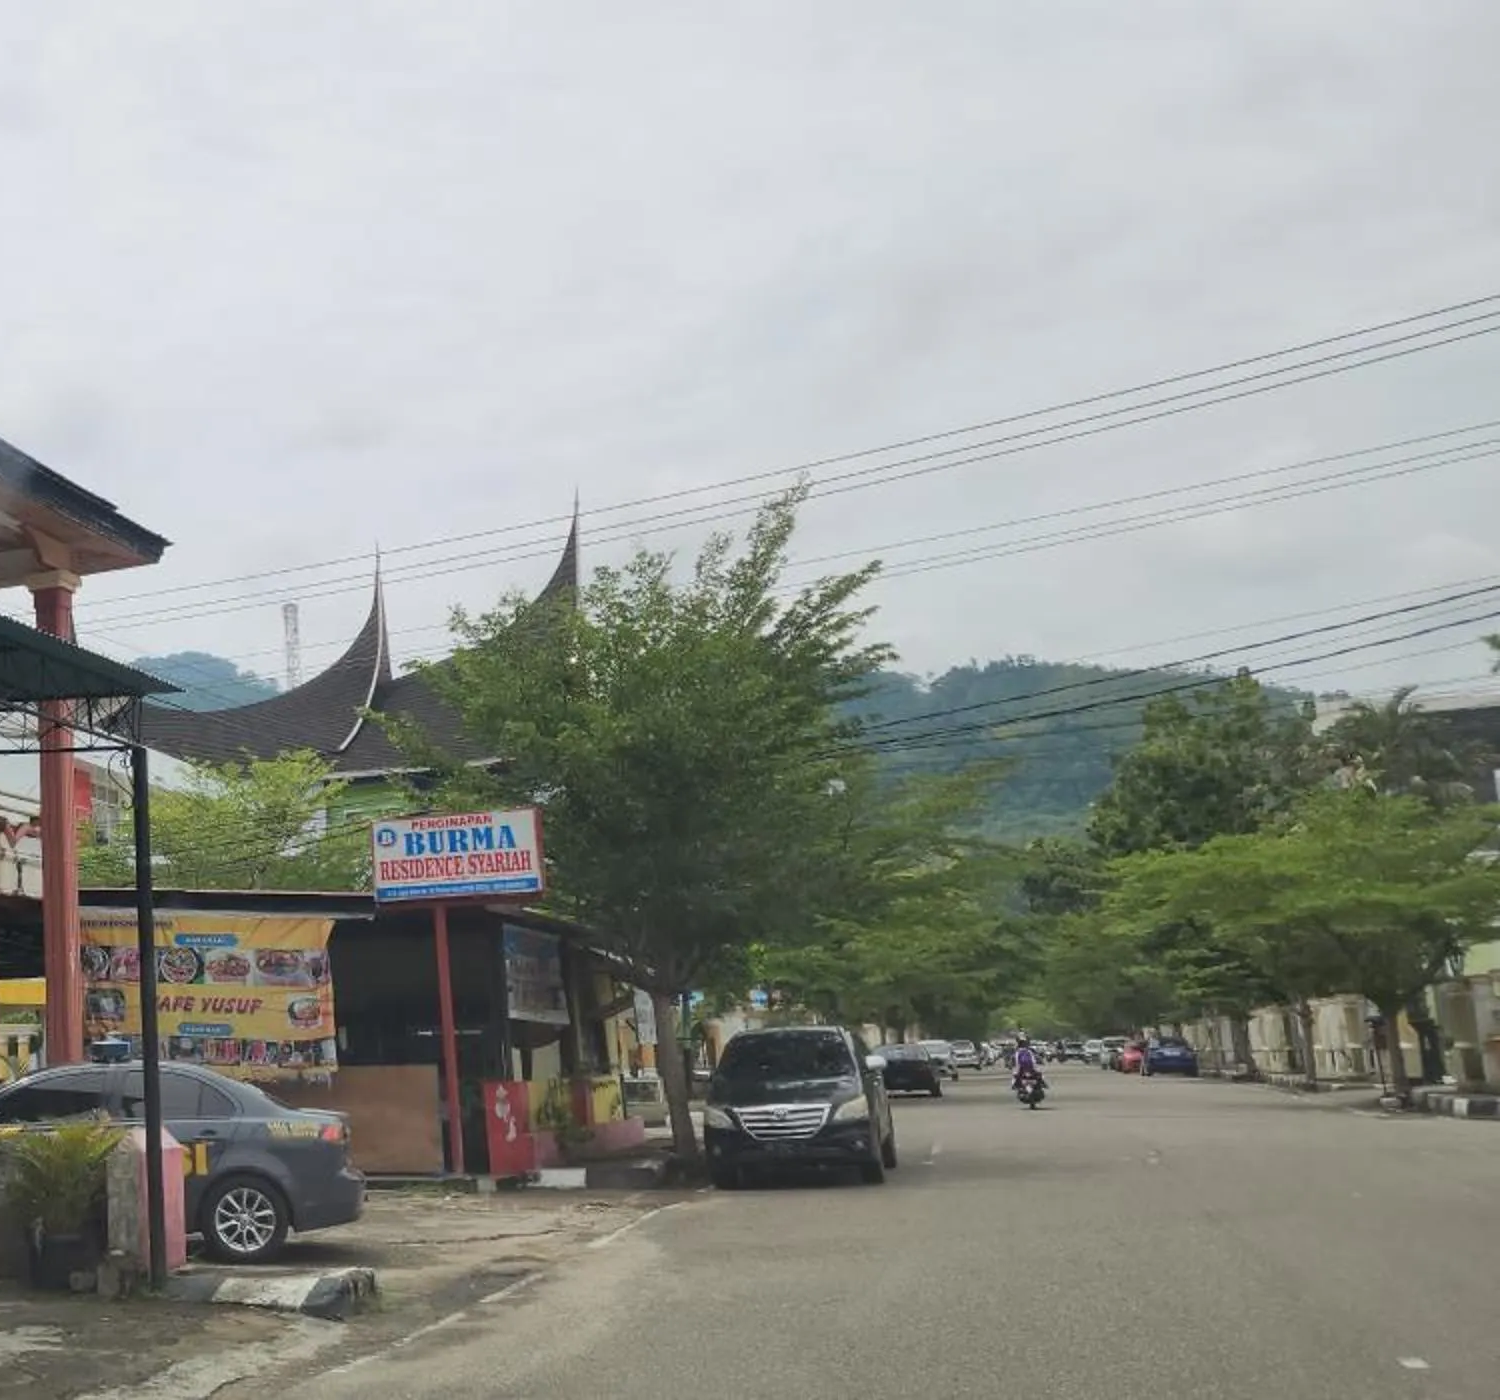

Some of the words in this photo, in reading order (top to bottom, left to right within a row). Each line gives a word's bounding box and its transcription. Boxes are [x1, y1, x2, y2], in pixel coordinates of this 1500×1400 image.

[412, 815, 493, 831] PENGINAPAN
[403, 825, 516, 857] BURMA
[379, 855, 465, 882] RESIDENCE
[467, 850, 532, 875] SYARIAH
[155, 995, 195, 1013] AFE
[202, 996, 263, 1015] YUSUF
